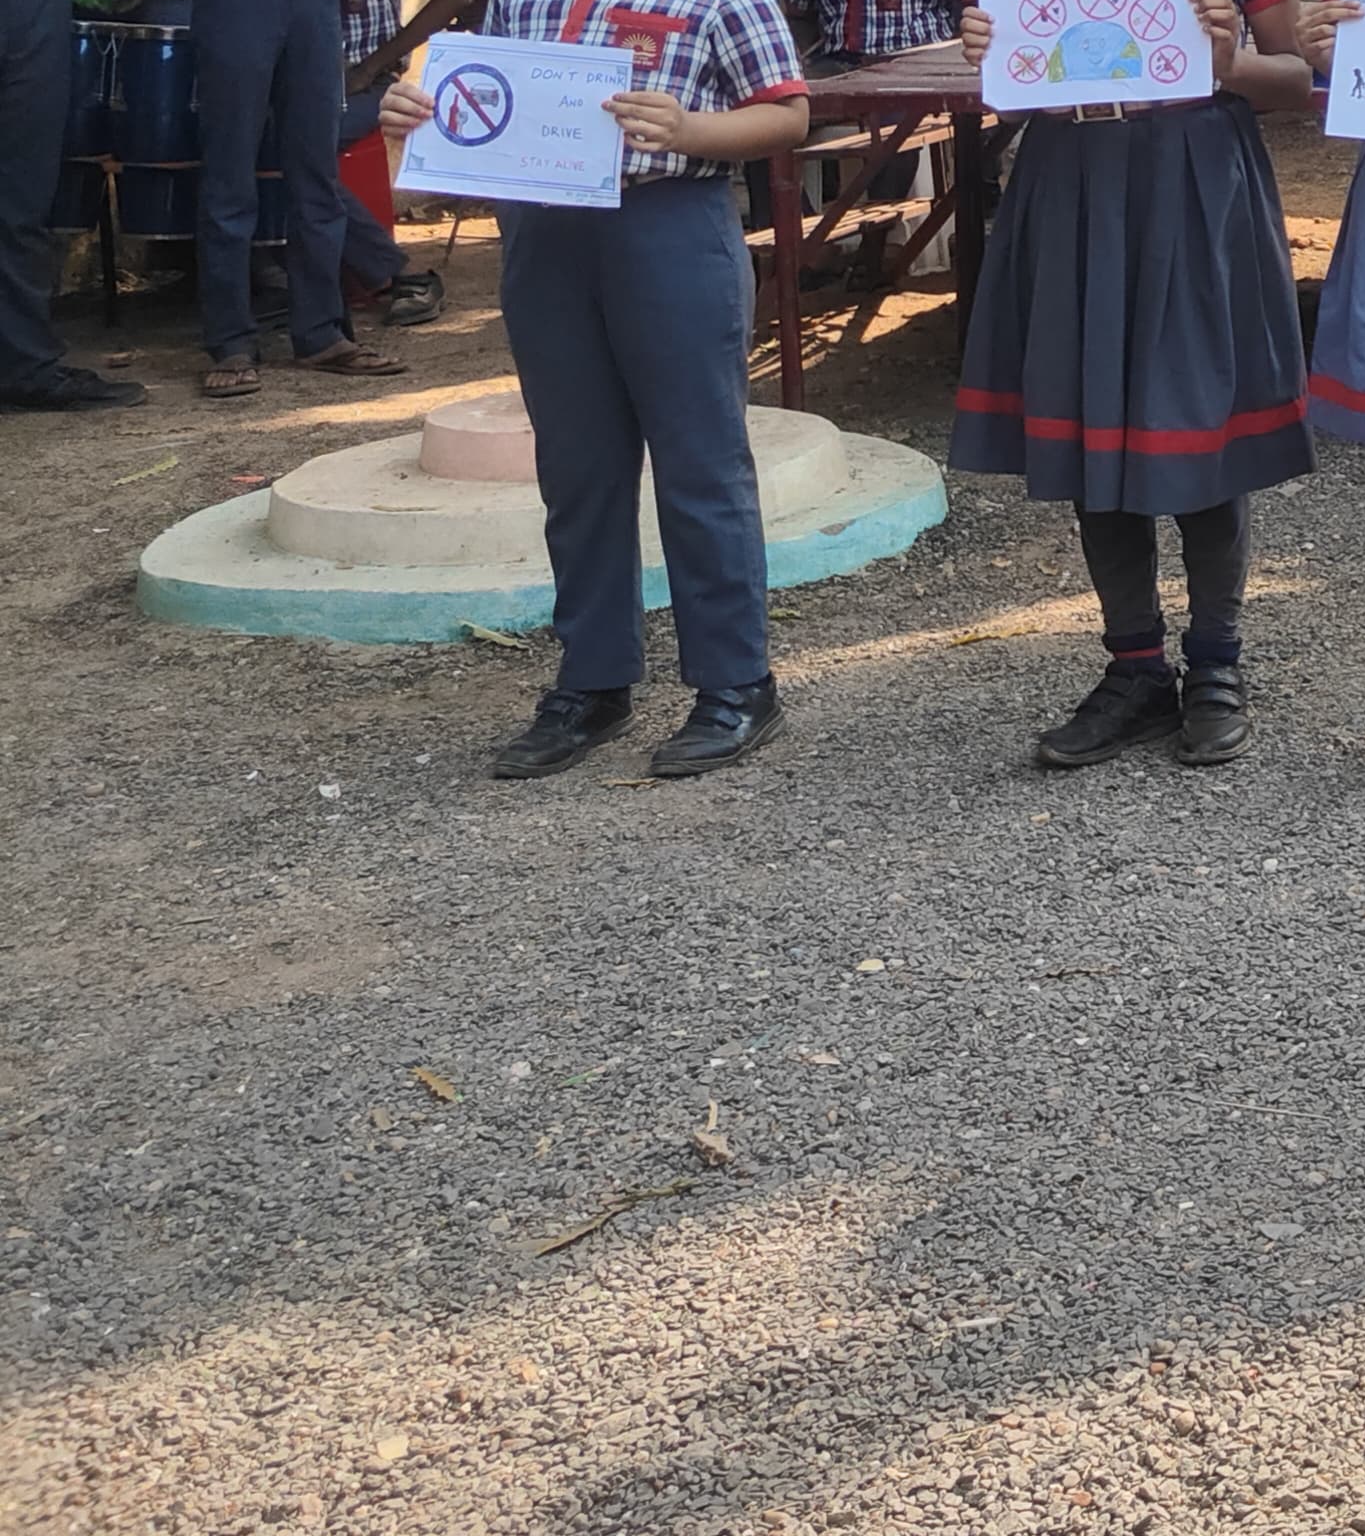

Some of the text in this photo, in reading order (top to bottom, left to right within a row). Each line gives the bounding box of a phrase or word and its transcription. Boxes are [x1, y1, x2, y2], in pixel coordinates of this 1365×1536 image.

[586, 70, 625, 87] DRINK
[541, 126, 583, 140] DRIVE
[519, 156, 586, 172] STAY ALIVE
